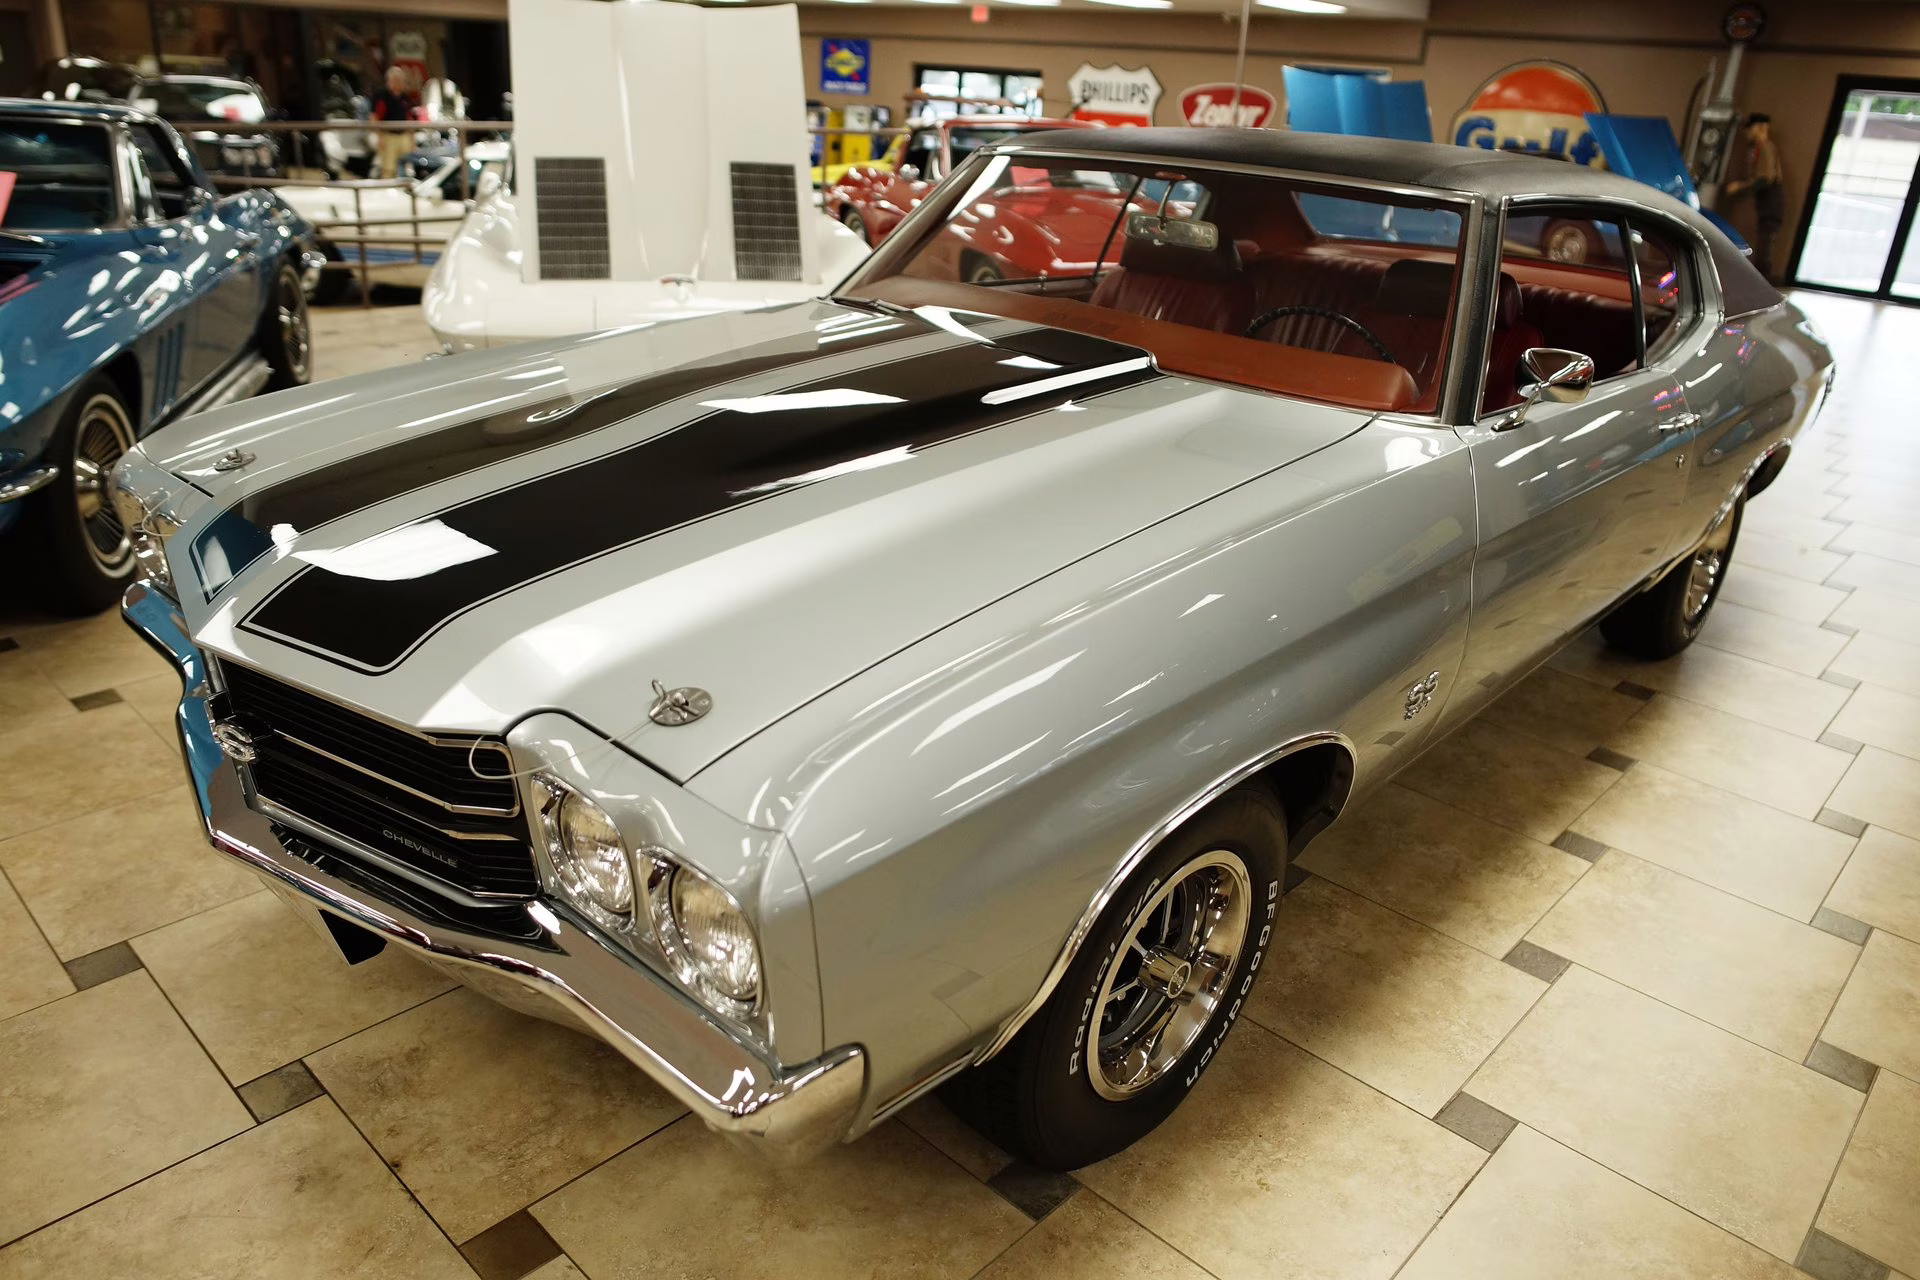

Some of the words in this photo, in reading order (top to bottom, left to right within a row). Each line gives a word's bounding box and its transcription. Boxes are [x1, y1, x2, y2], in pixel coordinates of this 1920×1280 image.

[1081, 79, 1150, 104] PHILLIPS
[383, 829, 457, 868] CHEVELLE
[1069, 942, 1116, 1075] Radial
[1122, 878, 1160, 928] T/A
